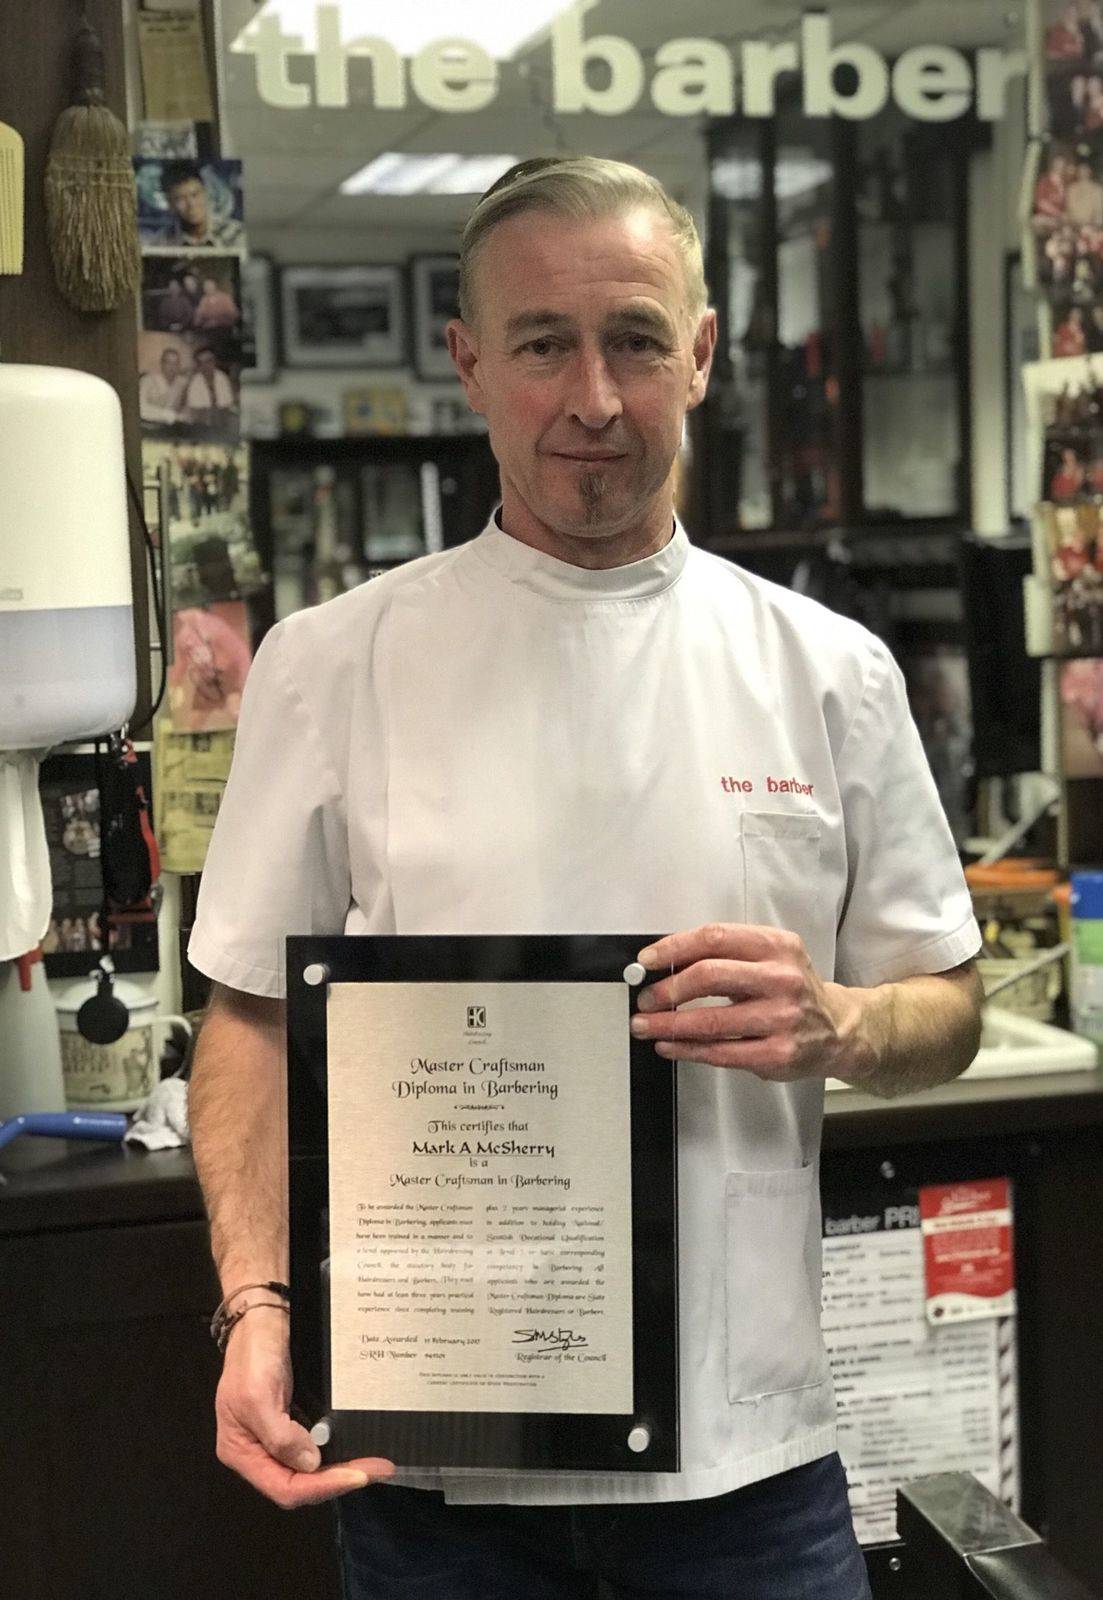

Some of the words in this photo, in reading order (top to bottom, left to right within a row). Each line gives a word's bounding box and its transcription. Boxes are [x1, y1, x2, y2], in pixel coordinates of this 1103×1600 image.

[243, 5, 499, 113] the
[552, 5, 1029, 122] barber
[721, 776, 753, 793] the
[767, 776, 814, 795] barber
[410, 1058, 464, 1075] Master
[469, 1058, 545, 1077] Craftsman
[392, 1080, 457, 1099] Diploma
[463, 1080, 475, 1094] in
[481, 1080, 559, 1100] Barbering
[428, 1120, 457, 1133] This
[460, 1120, 505, 1135] certifies
[508, 1121, 529, 1132] that
[413, 1140, 455, 1154] Mark
[459, 1141, 472, 1154] A
[477, 1140, 555, 1157] McSherry
[469, 1157, 478, 1168] is
[481, 1159, 489, 1168] a
[390, 1174, 431, 1187] Master
[434, 1174, 493, 1189] Craftsman
[497, 1174, 508, 1187] in
[510, 1174, 571, 1189] Barbering
[361, 1335, 380, 1344] Date
[382, 1335, 418, 1345] Awarded
[432, 1337, 466, 1346] February
[515, 1353, 552, 1363] Registrar
[553, 1353, 562, 1363] of
[564, 1353, 575, 1361] the
[578, 1353, 607, 1362] Council
